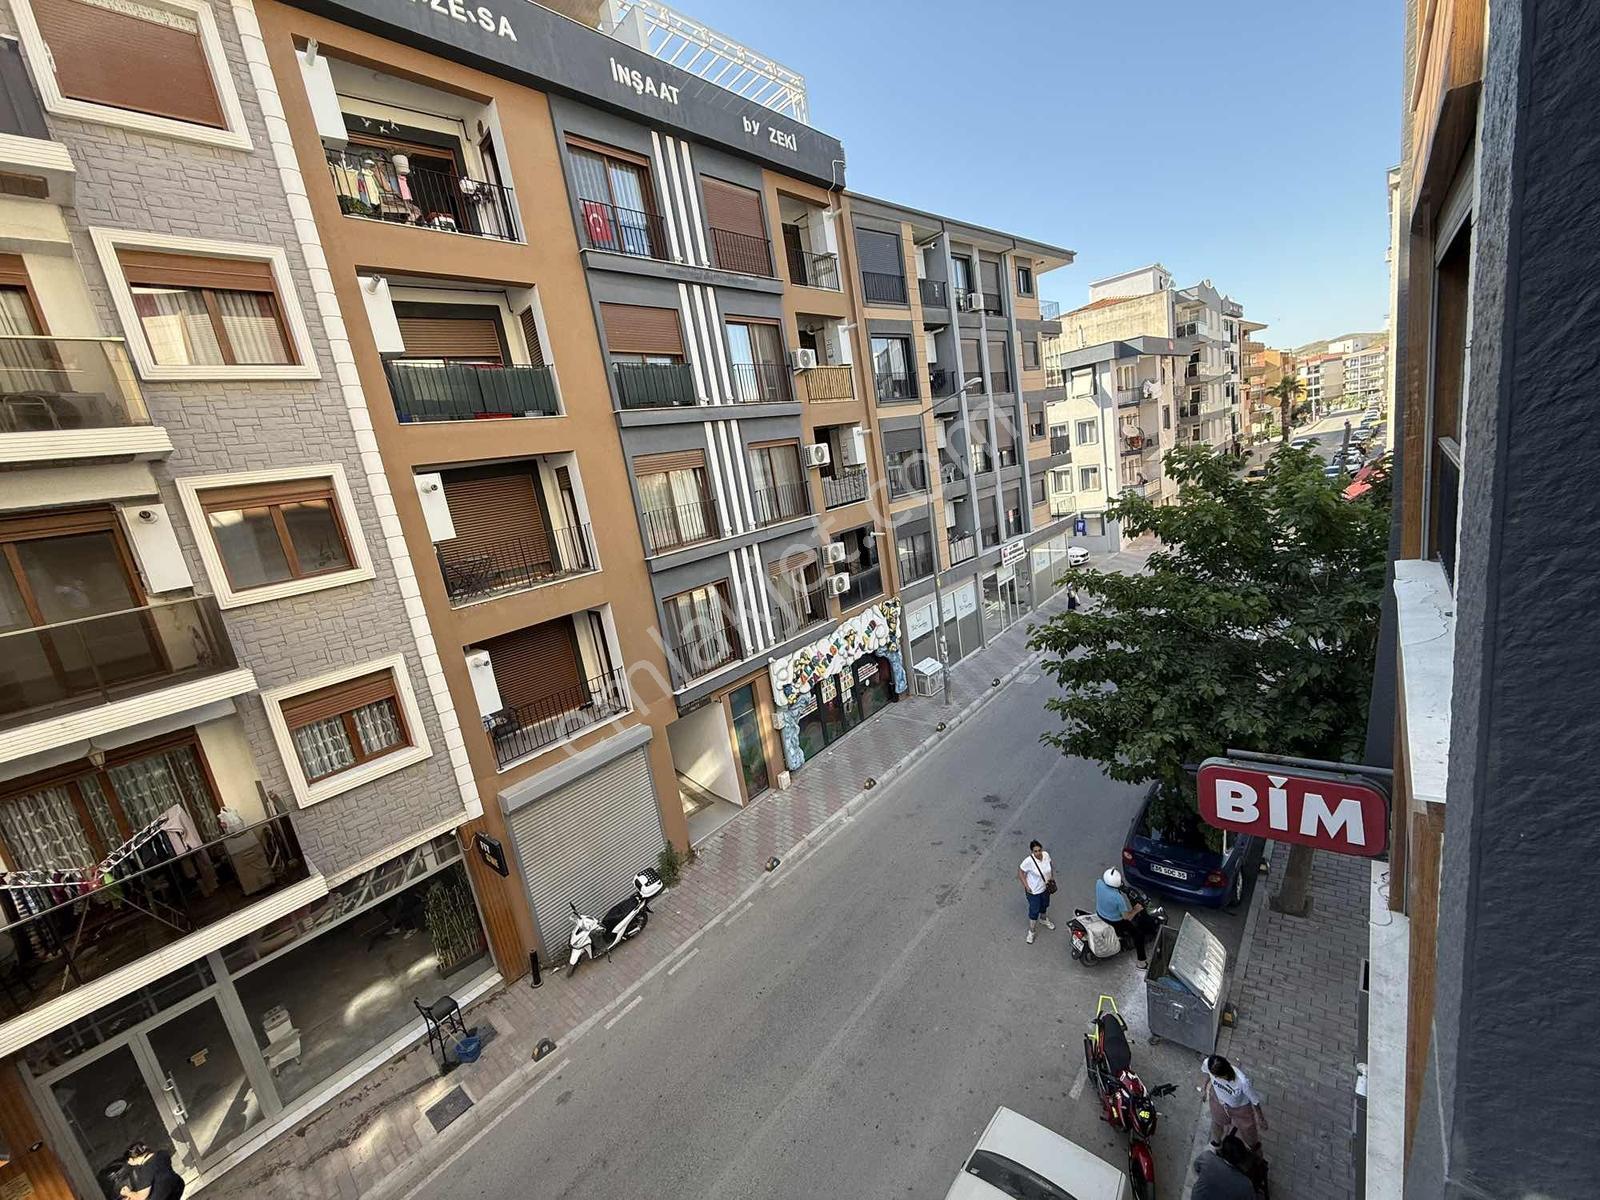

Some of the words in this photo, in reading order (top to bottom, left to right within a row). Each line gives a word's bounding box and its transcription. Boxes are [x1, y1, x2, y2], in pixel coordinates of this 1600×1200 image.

[609, 57, 680, 105] İNŞAAT
[743, 115, 760, 136] by
[1215, 775, 1366, 847] BİM
